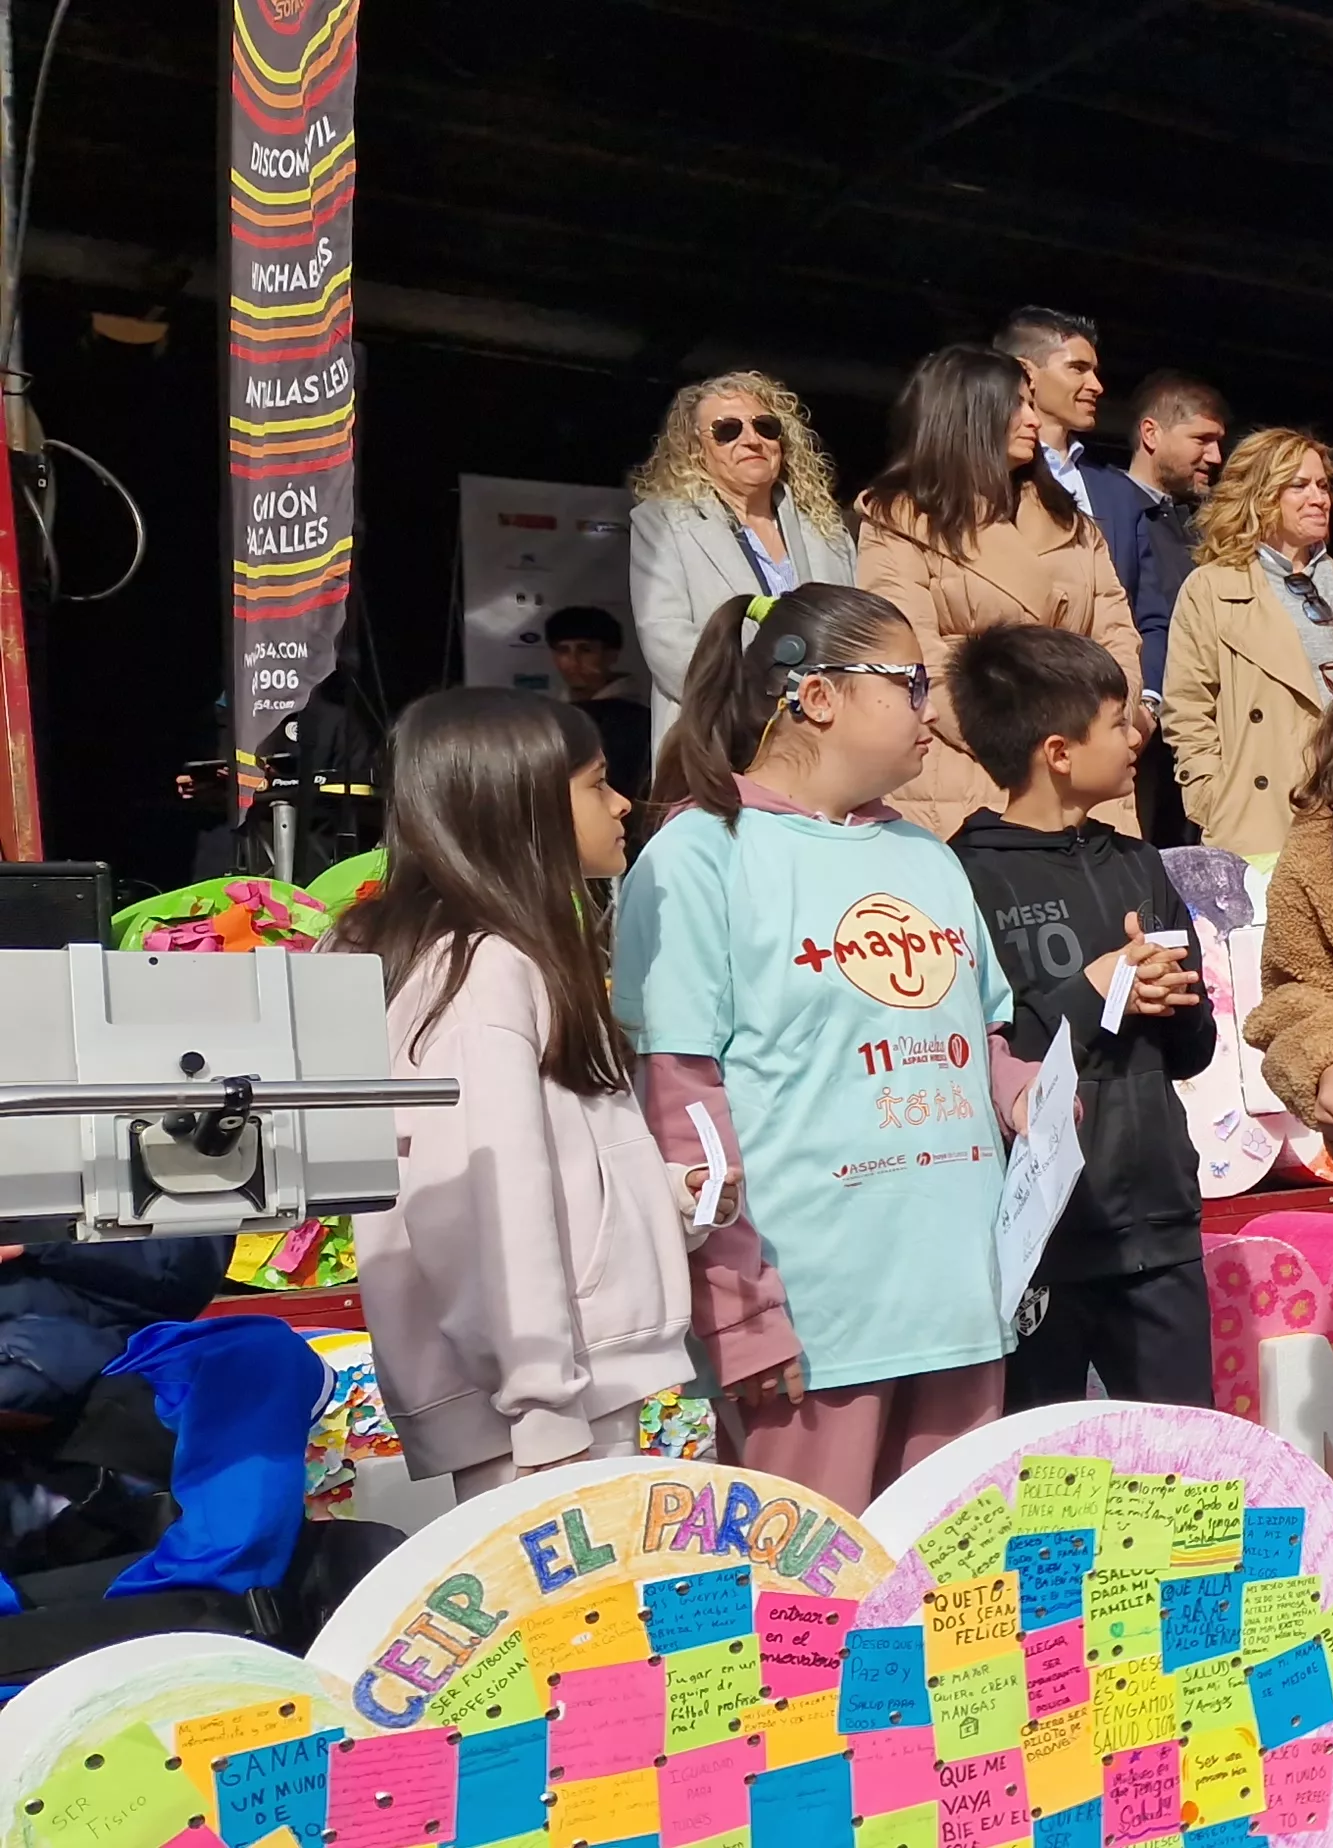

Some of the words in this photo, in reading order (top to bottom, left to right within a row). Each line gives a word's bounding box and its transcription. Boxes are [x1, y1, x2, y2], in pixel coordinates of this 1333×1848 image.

[996, 899, 1070, 930] MESSI
[1003, 922, 1084, 980] 10
[849, 1154, 907, 1174] ASPACE
[1074, 1465, 1097, 1481] SER
[962, 1505, 1006, 1542] quiero
[1020, 1504, 1054, 1518] TENER
[518, 1507, 617, 1596] EL
[642, 1480, 864, 1597] PARQUE
[1090, 1584, 1127, 1603] PARA
[1131, 1579, 1149, 1592] MI
[768, 1604, 824, 1625] entrar
[932, 1611, 966, 1633] DOS
[976, 1603, 1017, 1624] SEAN
[1090, 1593, 1156, 1621] FAMILIA
[765, 1632, 783, 1643] en
[791, 1630, 811, 1647] el
[665, 1667, 713, 1688] Jugar
[1281, 1661, 1320, 1689] MEJORE
[430, 1688, 461, 1716] SER
[940, 1697, 996, 1723] MANGAS
[1092, 1693, 1175, 1727] TENGAMOS
[219, 1735, 330, 1787] GANAR
[939, 1762, 978, 1789] QUE
[230, 1788, 266, 1813] UN
[941, 1789, 992, 1816] VAYA
[254, 1804, 291, 1826] DE
